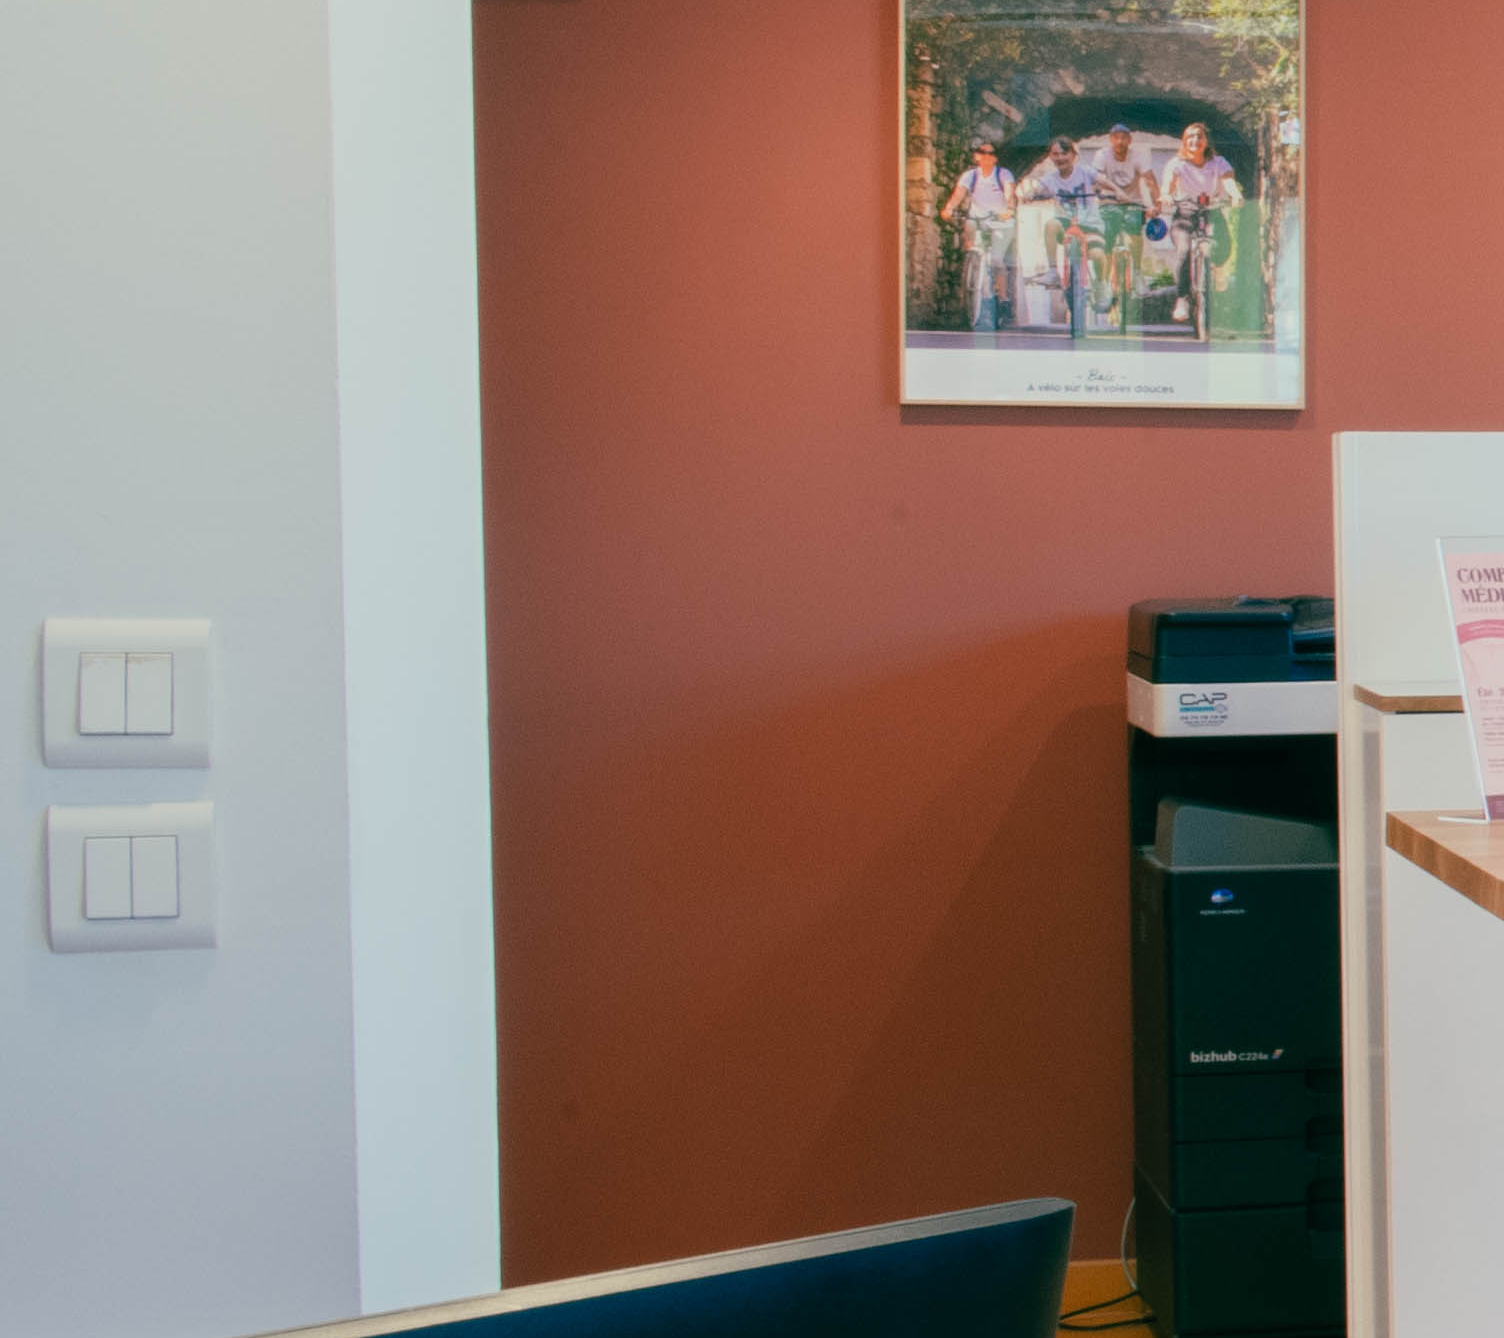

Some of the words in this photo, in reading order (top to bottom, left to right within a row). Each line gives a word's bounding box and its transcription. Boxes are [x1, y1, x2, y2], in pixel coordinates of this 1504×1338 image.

[1064, 384, 1081, 393] sur
[1084, 383, 1099, 393] les
[1134, 383, 1174, 394] douces
[1179, 692, 1227, 706] CAP
[1190, 1050, 1236, 1062] bizhub
